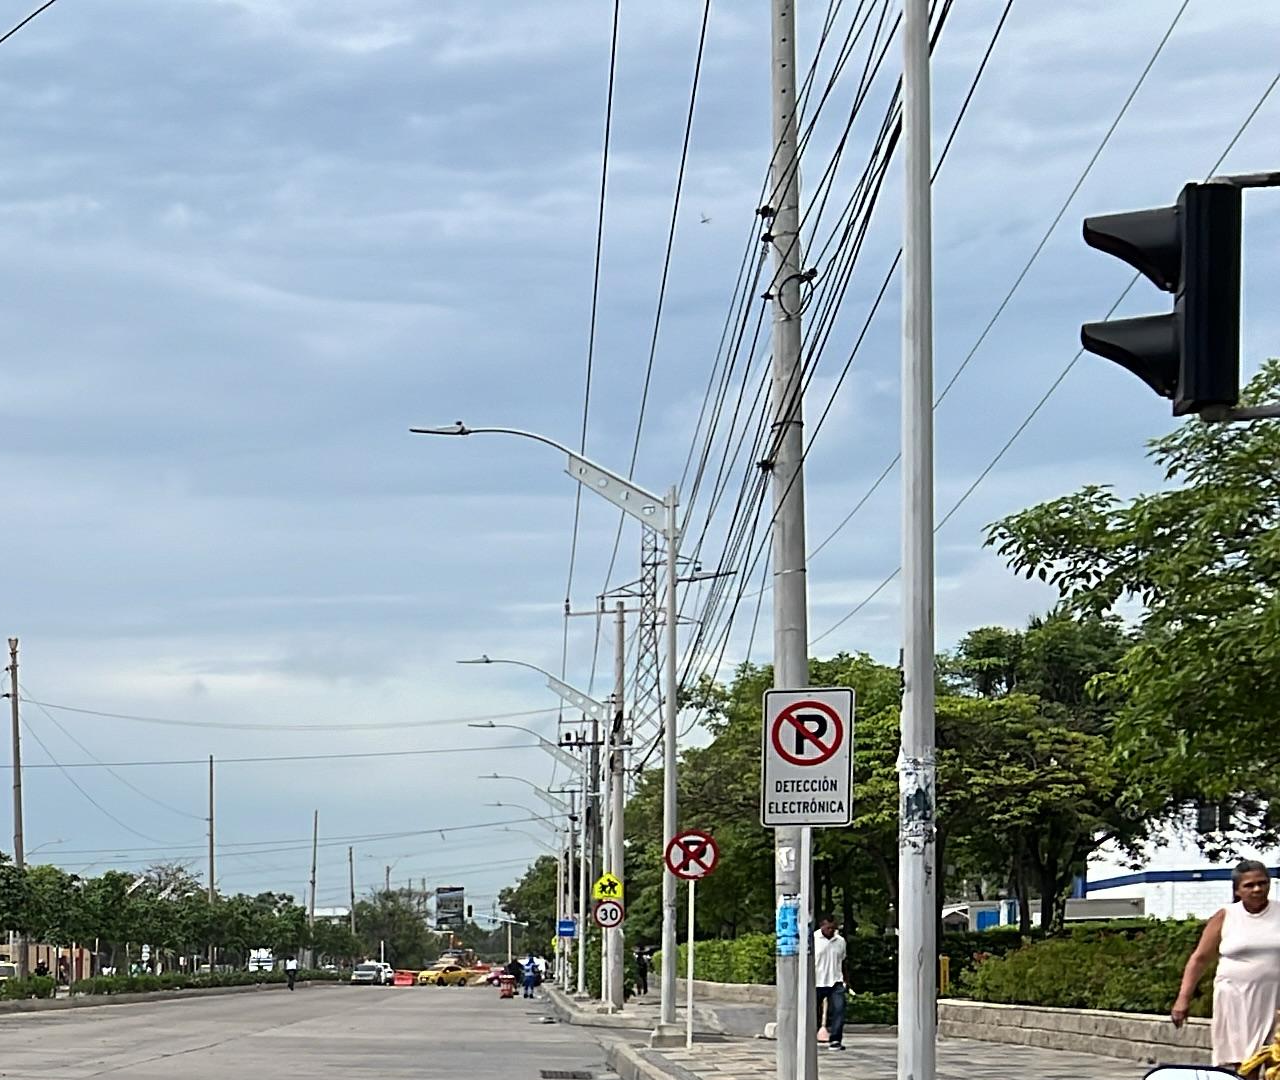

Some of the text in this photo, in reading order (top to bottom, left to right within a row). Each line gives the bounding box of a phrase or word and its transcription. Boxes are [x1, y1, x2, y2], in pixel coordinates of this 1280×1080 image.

[795, 714, 827, 755] P
[775, 776, 838, 793] DETECCIÓN
[768, 797, 845, 814] ELECTRÓNICA
[600, 908, 618, 921] 30
